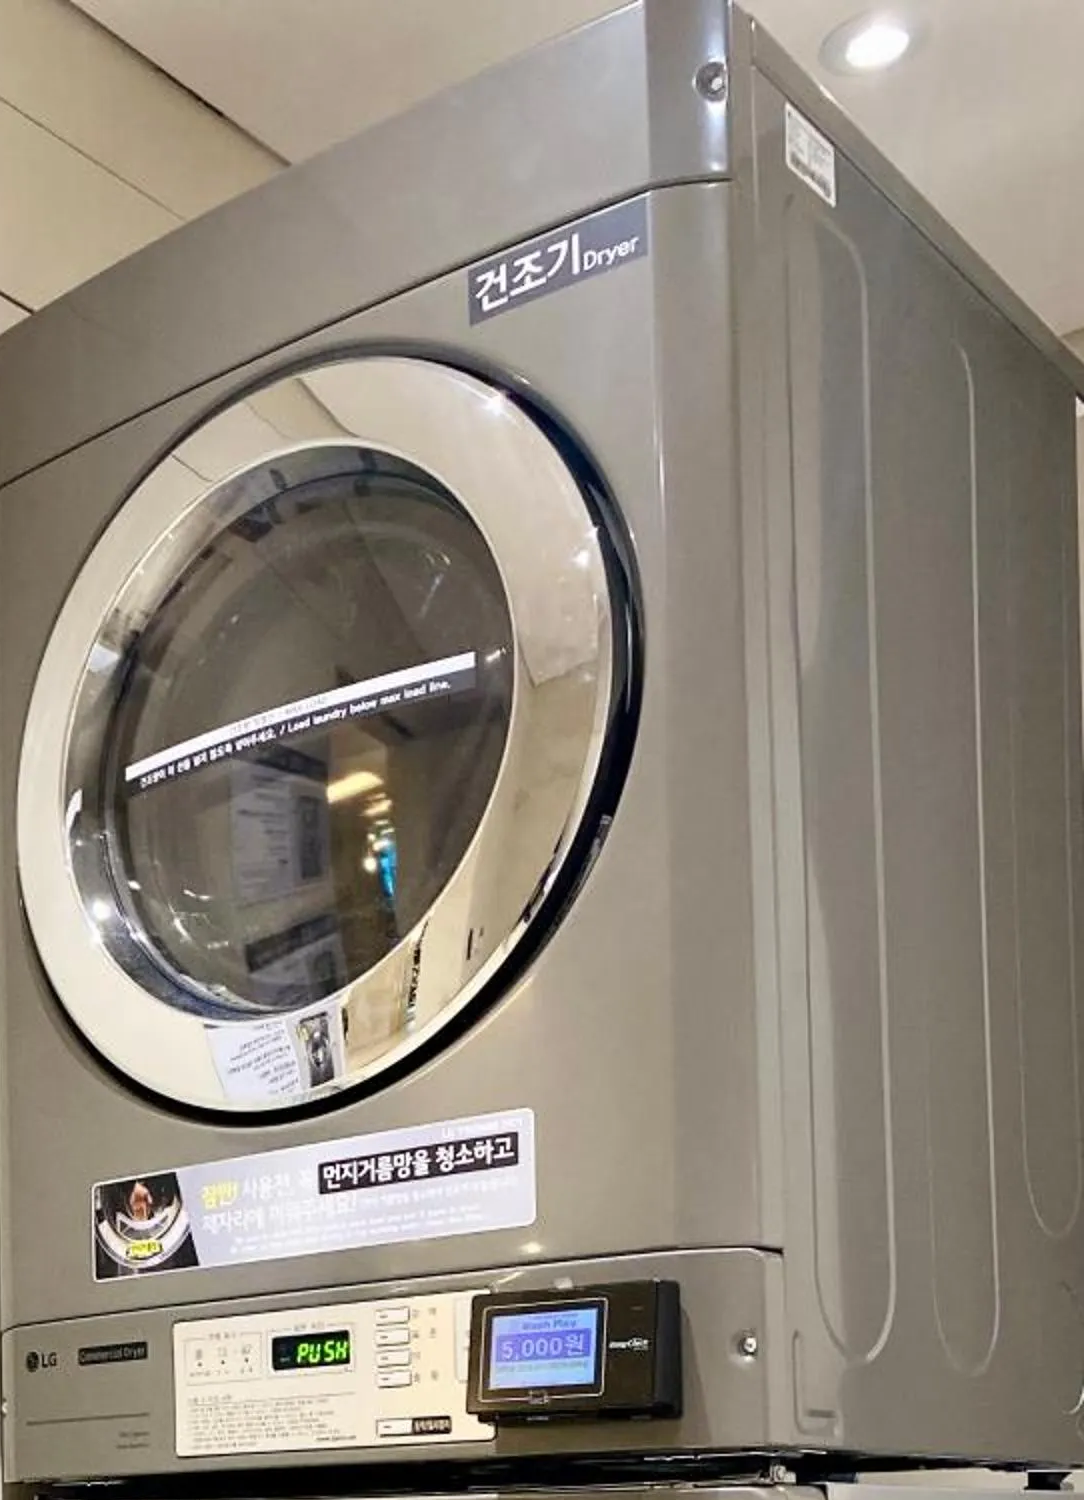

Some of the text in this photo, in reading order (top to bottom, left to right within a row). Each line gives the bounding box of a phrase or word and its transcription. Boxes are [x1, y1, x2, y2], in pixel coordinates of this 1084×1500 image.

[475, 233, 639, 312] 건조기 Dryer
[323, 1150, 432, 1190] 먼지거름망을
[436, 1136, 515, 1172] 청소하고
[41, 1351, 57, 1368] LG
[297, 1341, 349, 1363] PUSH
[501, 1333, 586, 1360] 5,000원
